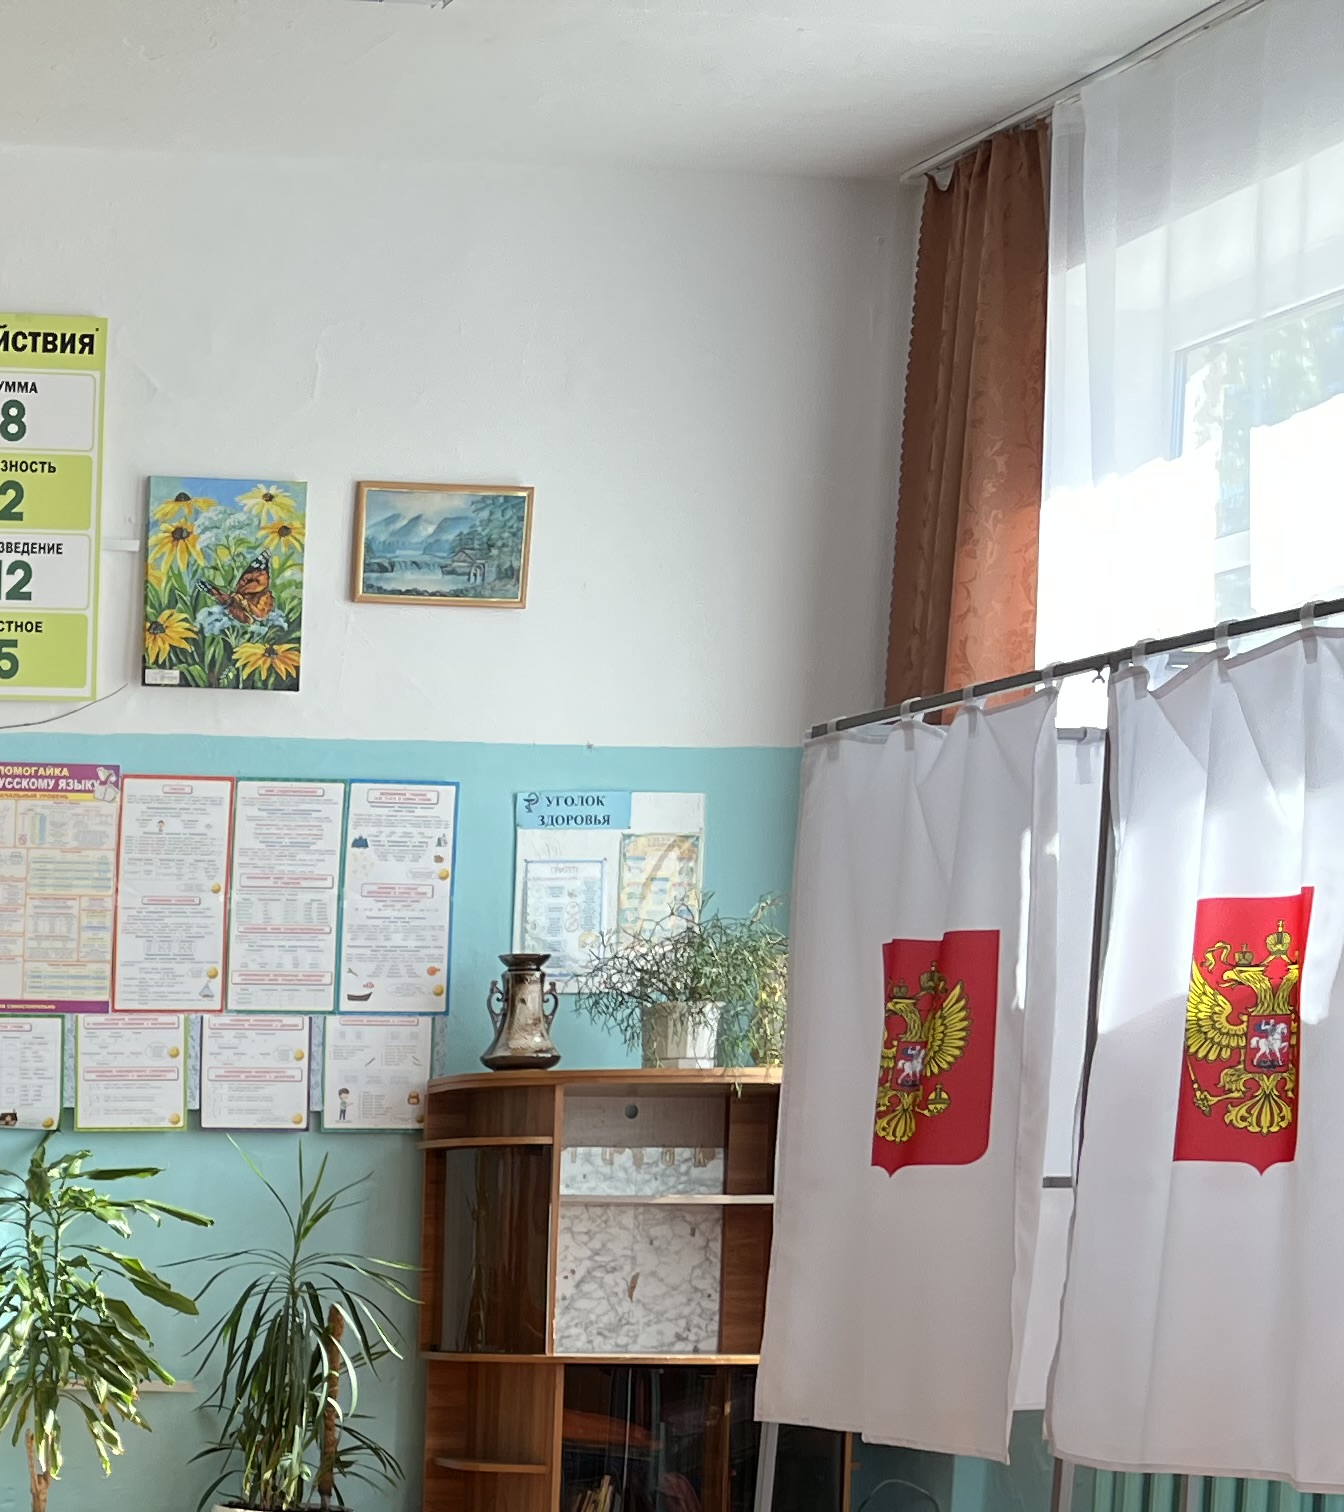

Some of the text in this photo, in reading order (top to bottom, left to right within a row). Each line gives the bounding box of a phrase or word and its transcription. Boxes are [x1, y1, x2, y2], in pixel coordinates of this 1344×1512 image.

[0, 400, 26, 441] 8
[58, 779, 100, 791] ЯЗЫКУ
[545, 795, 606, 808] УГОЛОК
[538, 814, 611, 827] ЗДОРОВЬЯ
